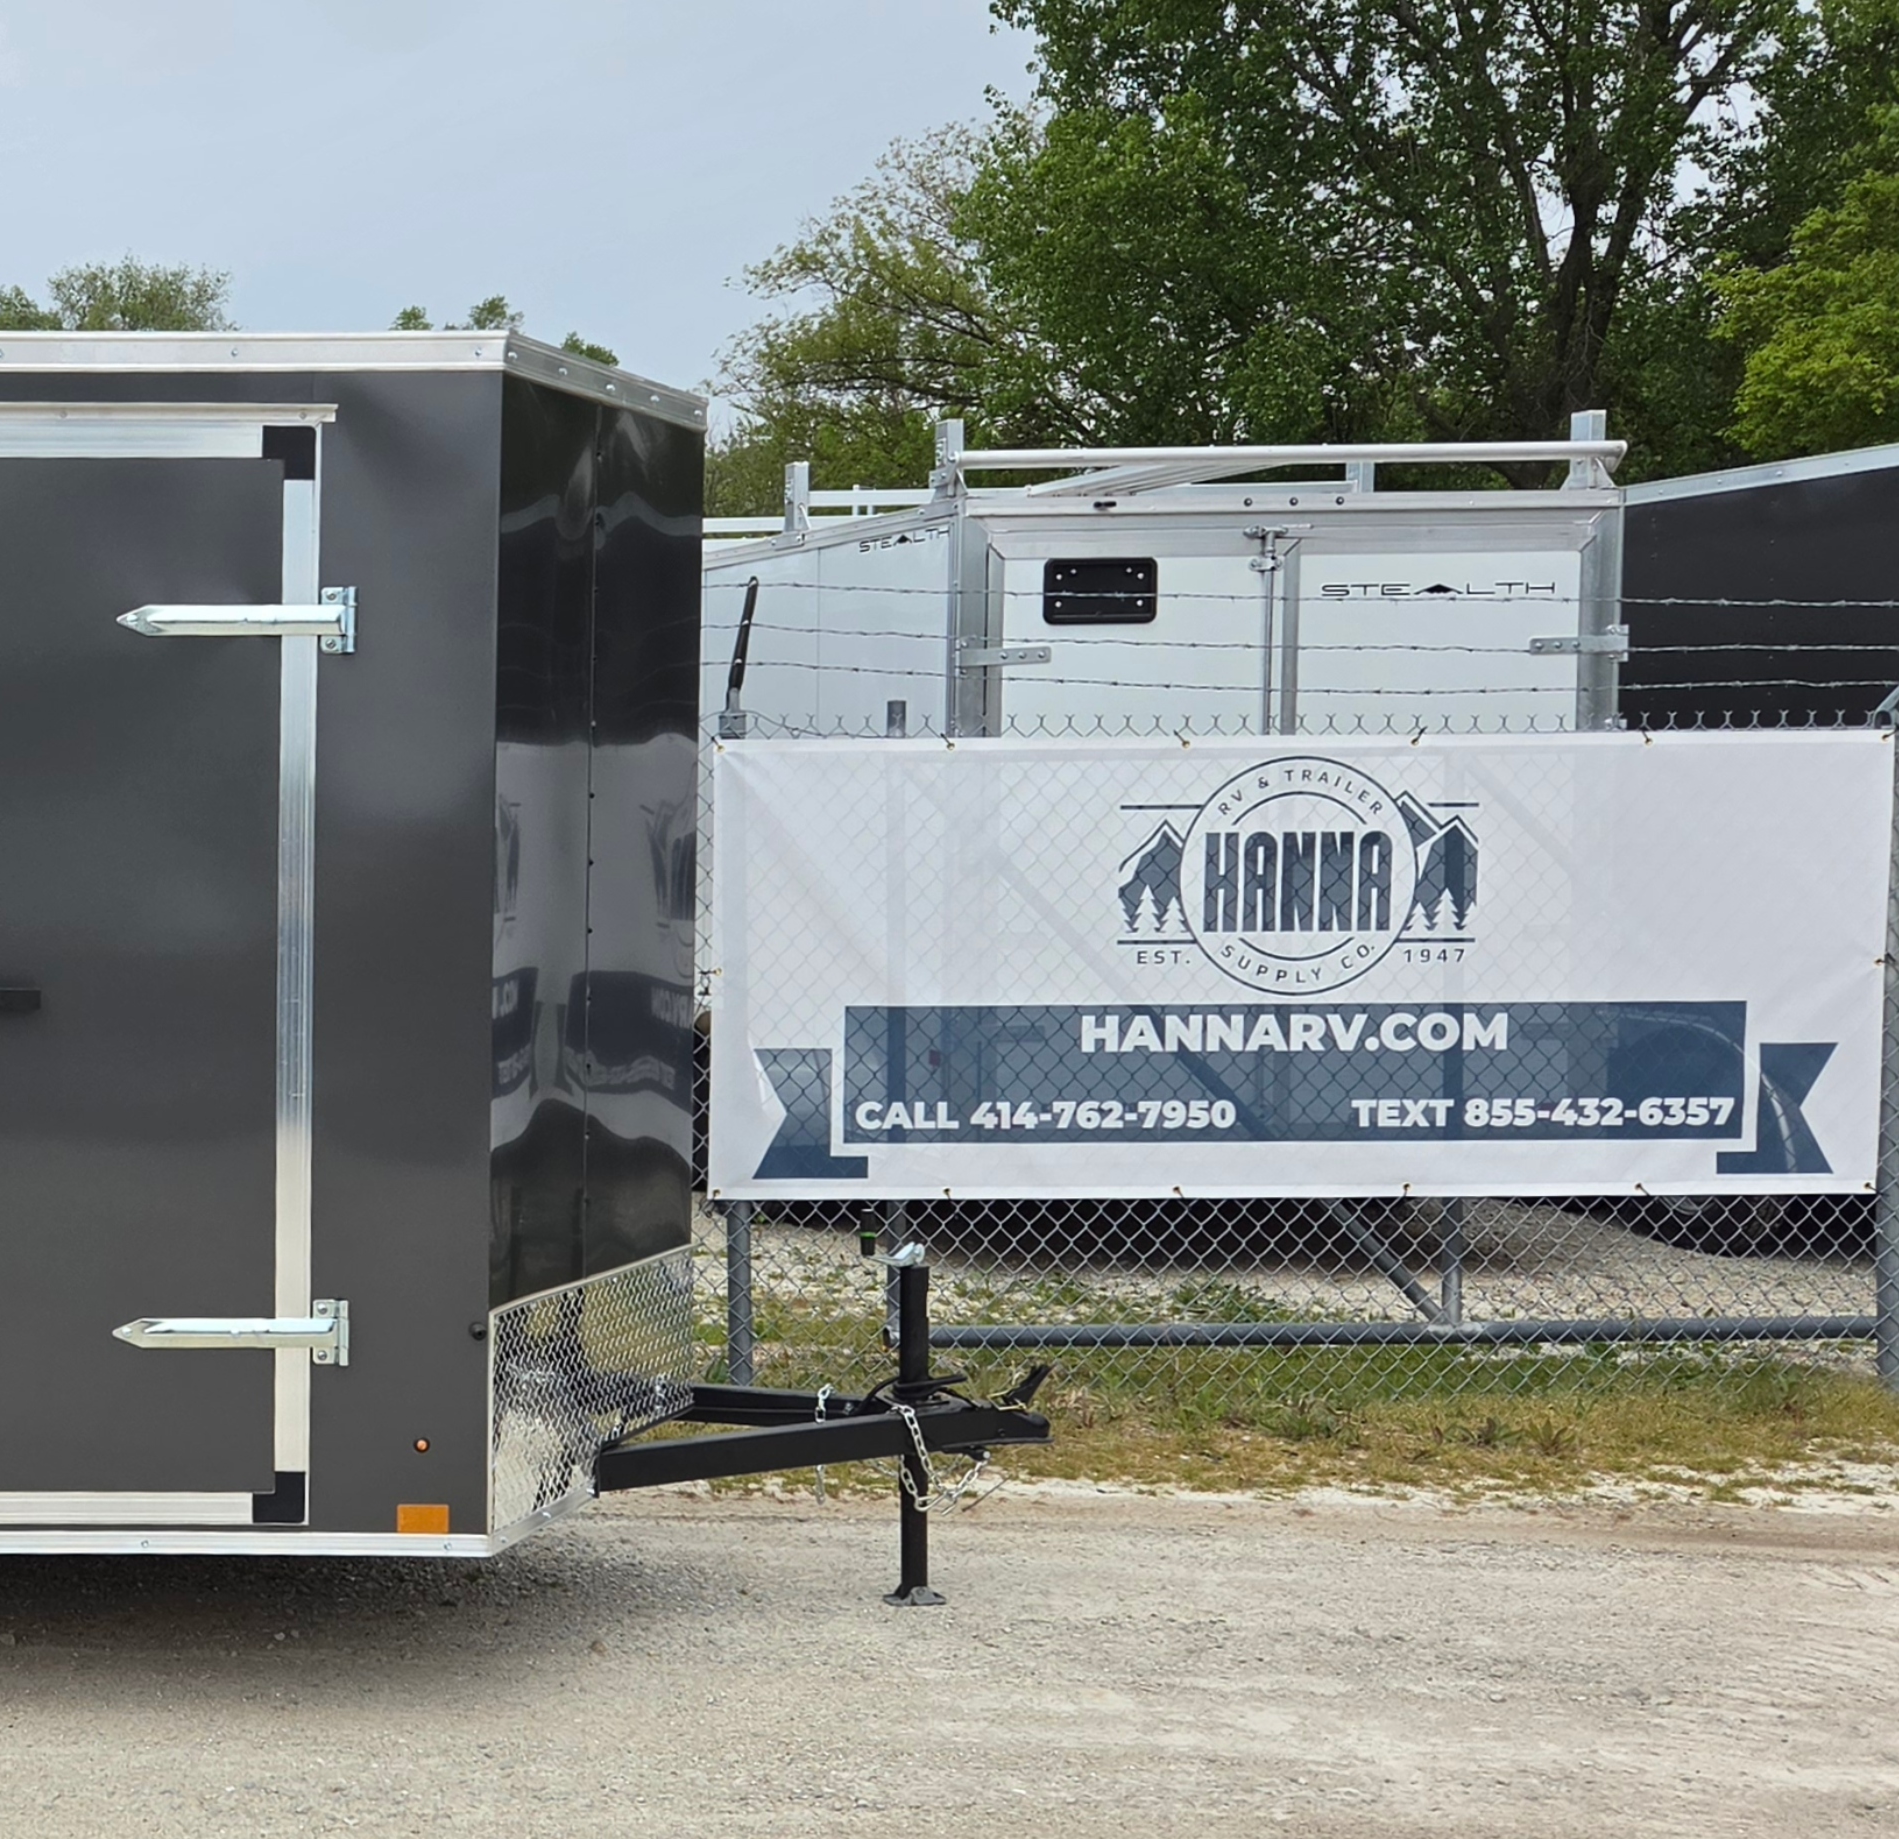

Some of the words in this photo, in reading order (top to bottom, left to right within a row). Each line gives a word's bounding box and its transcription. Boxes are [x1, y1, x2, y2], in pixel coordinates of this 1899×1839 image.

[859, 526, 950, 553] STEALTH
[1321, 582, 1556, 596] STEALTH
[1218, 788, 1245, 816] RV
[1257, 776, 1270, 790] &
[1284, 769, 1385, 815] TRAILER
[1202, 830, 1393, 933] HANNA
[1136, 950, 1191, 965] EST.
[1405, 948, 1466, 963] 1947
[1220, 943, 1323, 984] SUPPLY
[1341, 943, 1376, 970] CO.
[1080, 1012, 1509, 1053] HANNARV.COM
[854, 1101, 960, 1130] CALL
[969, 1100, 1237, 1130] 414-762-7950
[1351, 1099, 1454, 1128] TEXT
[1463, 1097, 1735, 1127] 855-432-6357
